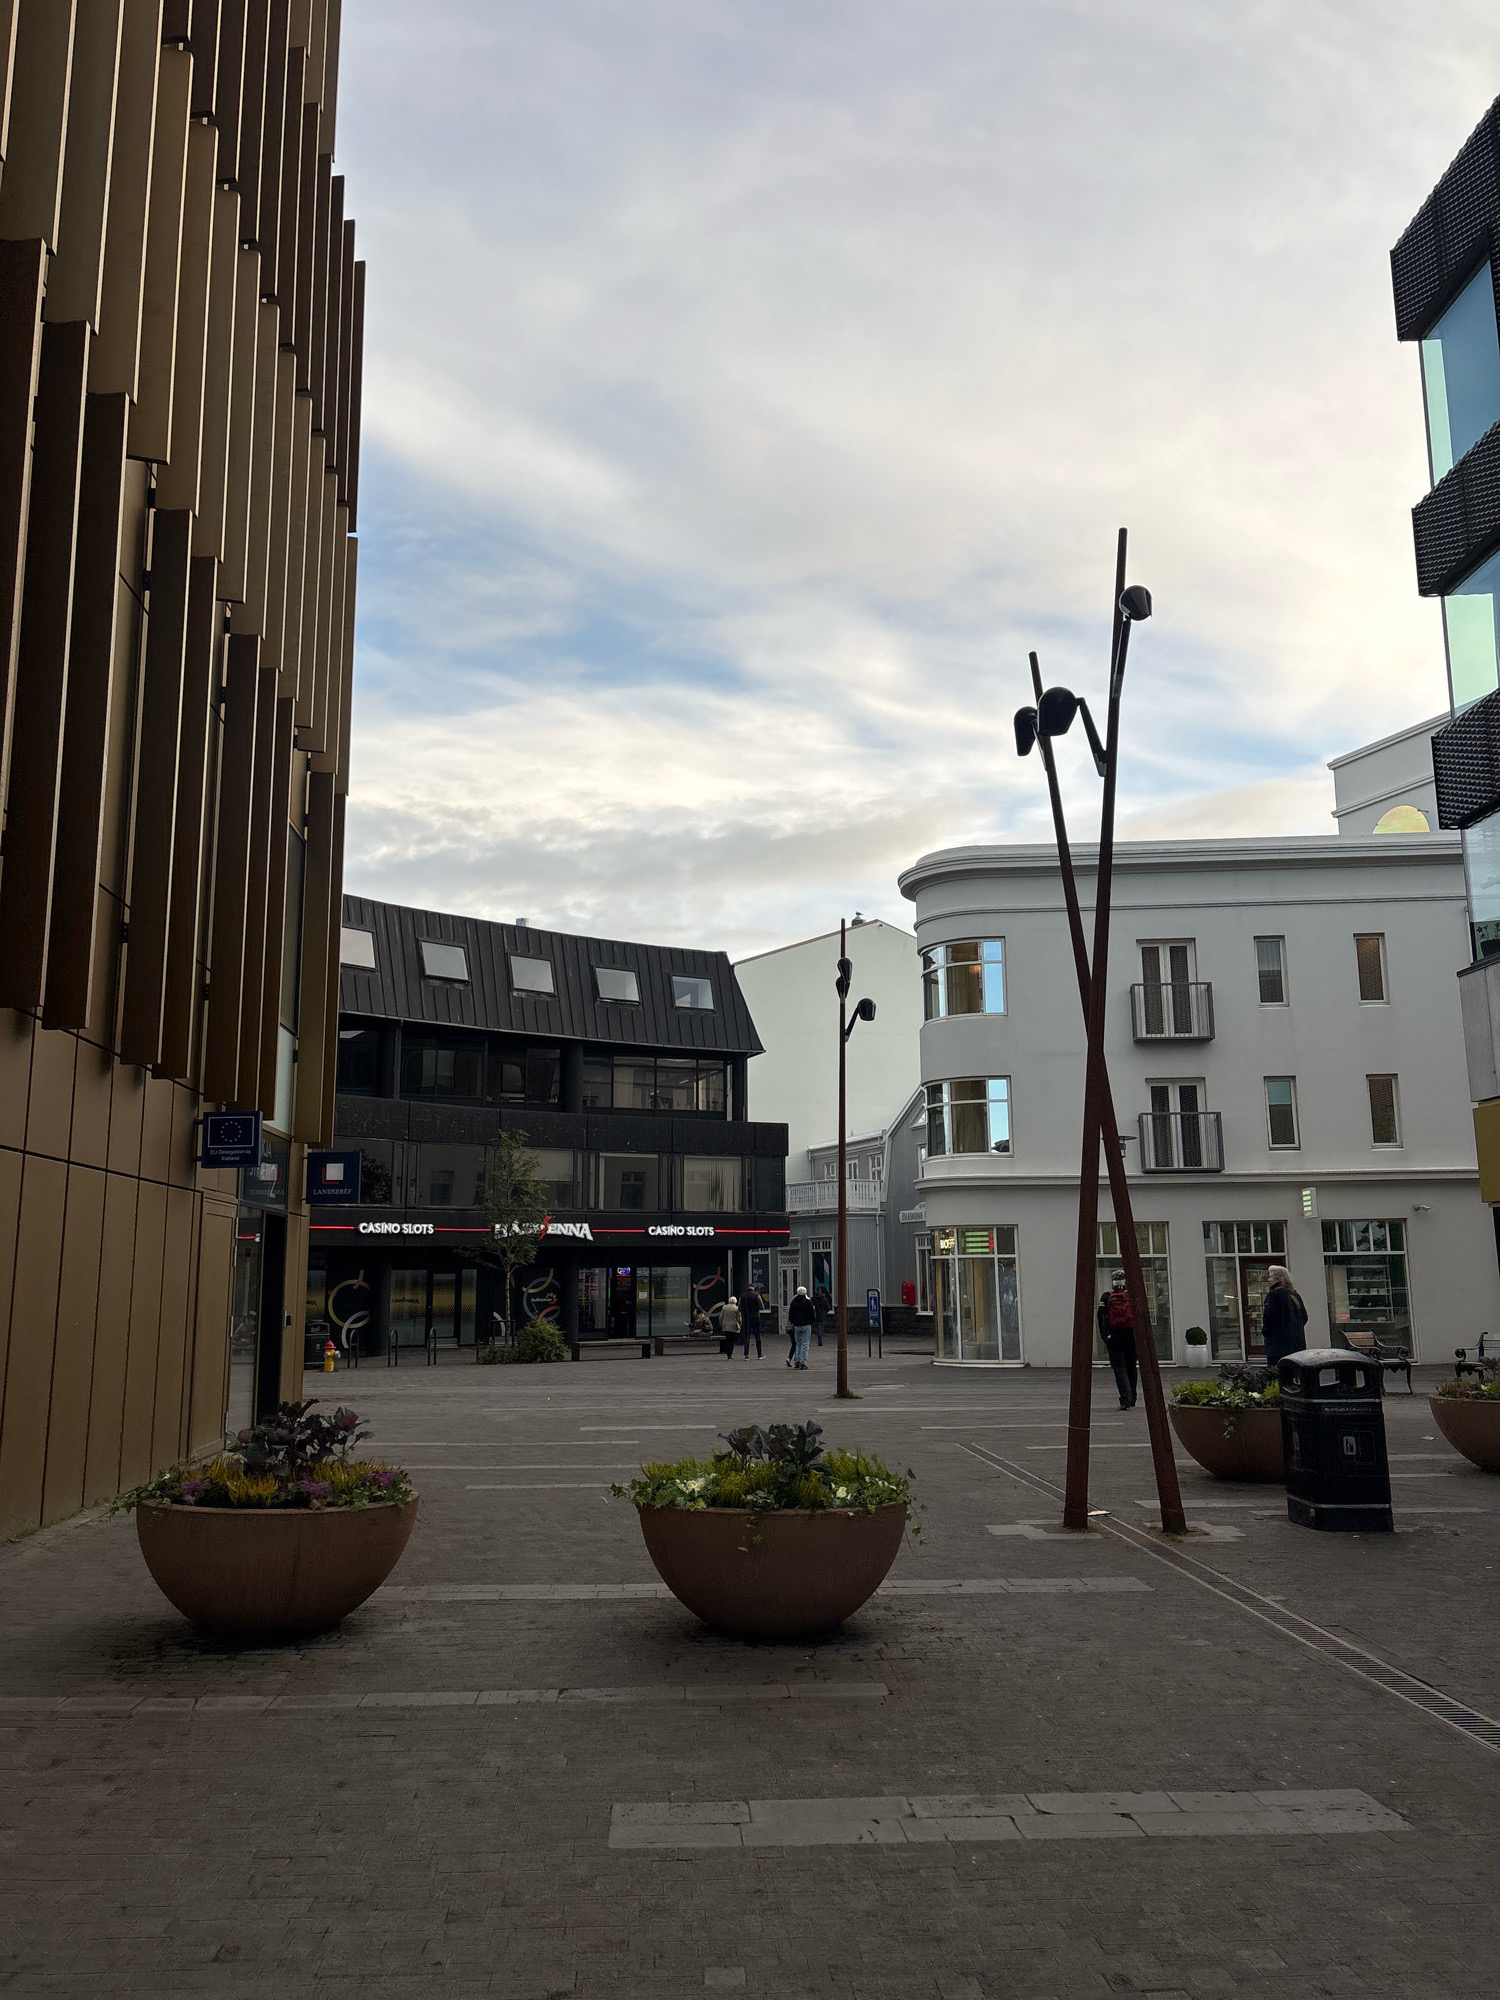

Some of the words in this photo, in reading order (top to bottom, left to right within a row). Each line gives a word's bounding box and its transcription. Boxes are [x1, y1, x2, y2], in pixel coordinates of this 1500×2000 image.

[313, 1187, 353, 1195] LANDSBRÉF
[359, 1221, 401, 1234] CASINO
[401, 1223, 435, 1235] SLOTS
[647, 1224, 685, 1236] CASINO
[685, 1225, 715, 1236] SLOTS
